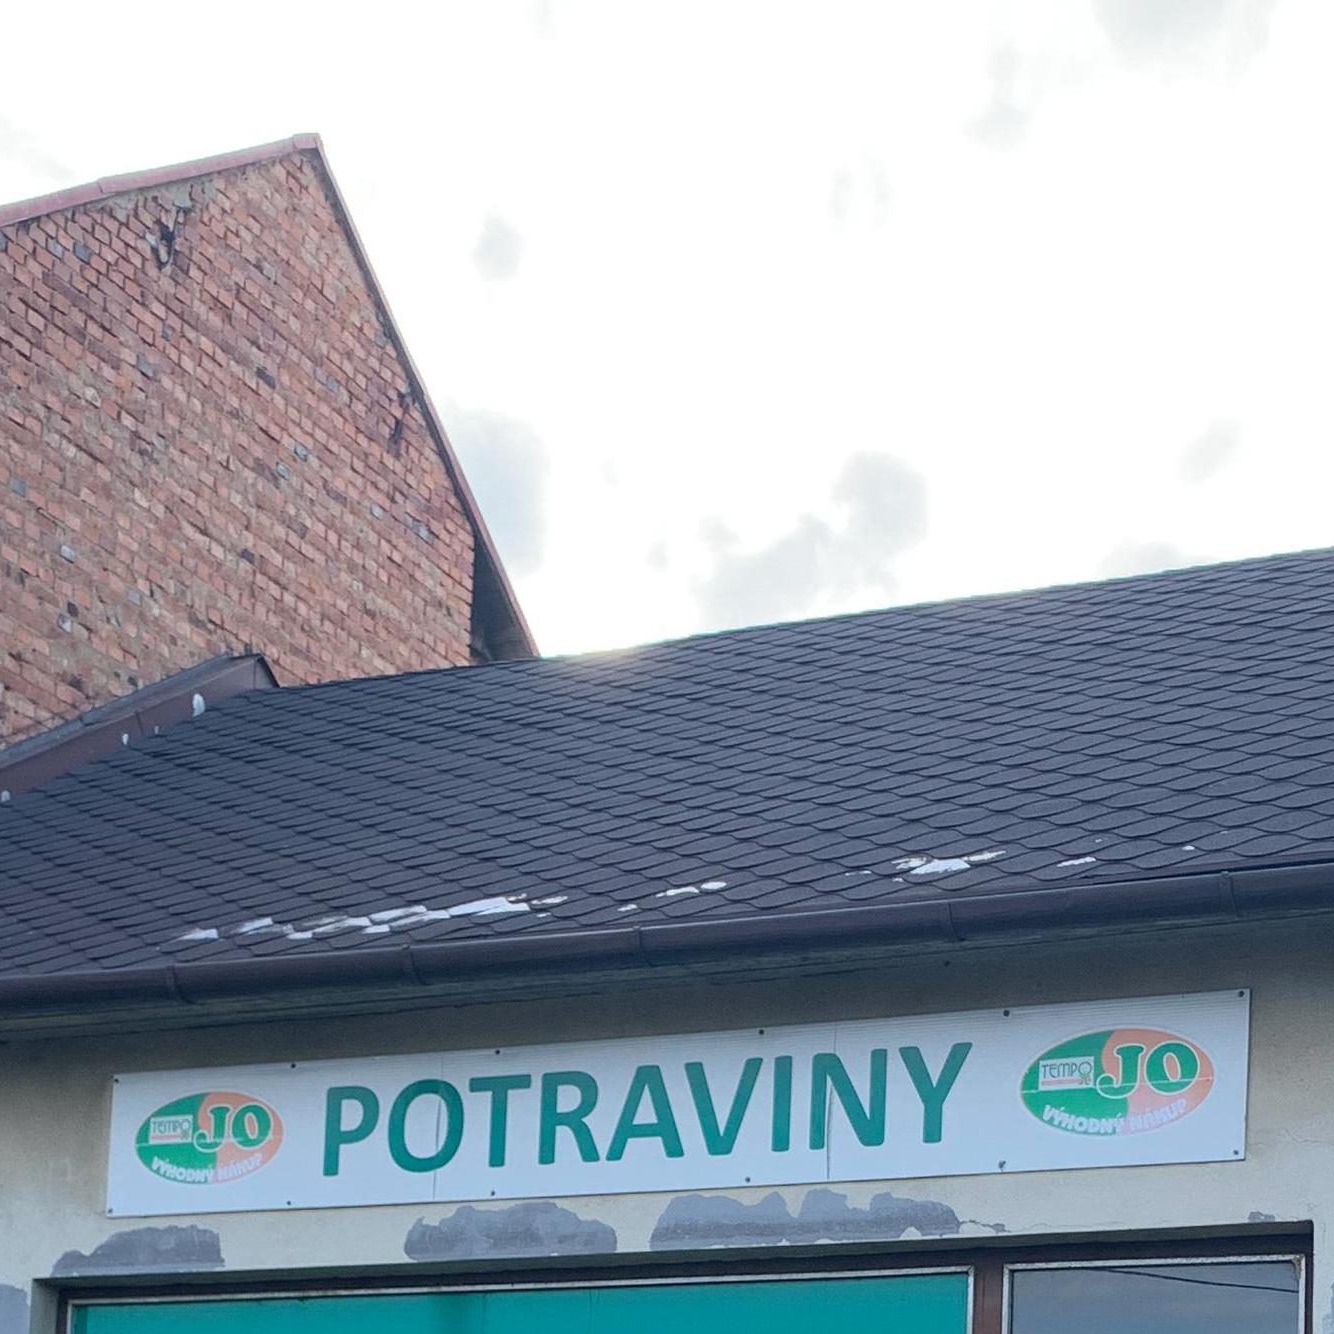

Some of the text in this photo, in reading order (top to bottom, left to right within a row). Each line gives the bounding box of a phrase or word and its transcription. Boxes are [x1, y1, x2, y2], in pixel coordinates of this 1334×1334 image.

[1041, 1061, 1092, 1078] TEMPO
[1096, 1040, 1200, 1099] JO
[193, 1102, 273, 1152] JO
[323, 1042, 973, 1177] POTRAVINY
[1042, 1104, 1125, 1134] VÝHODNÝ
